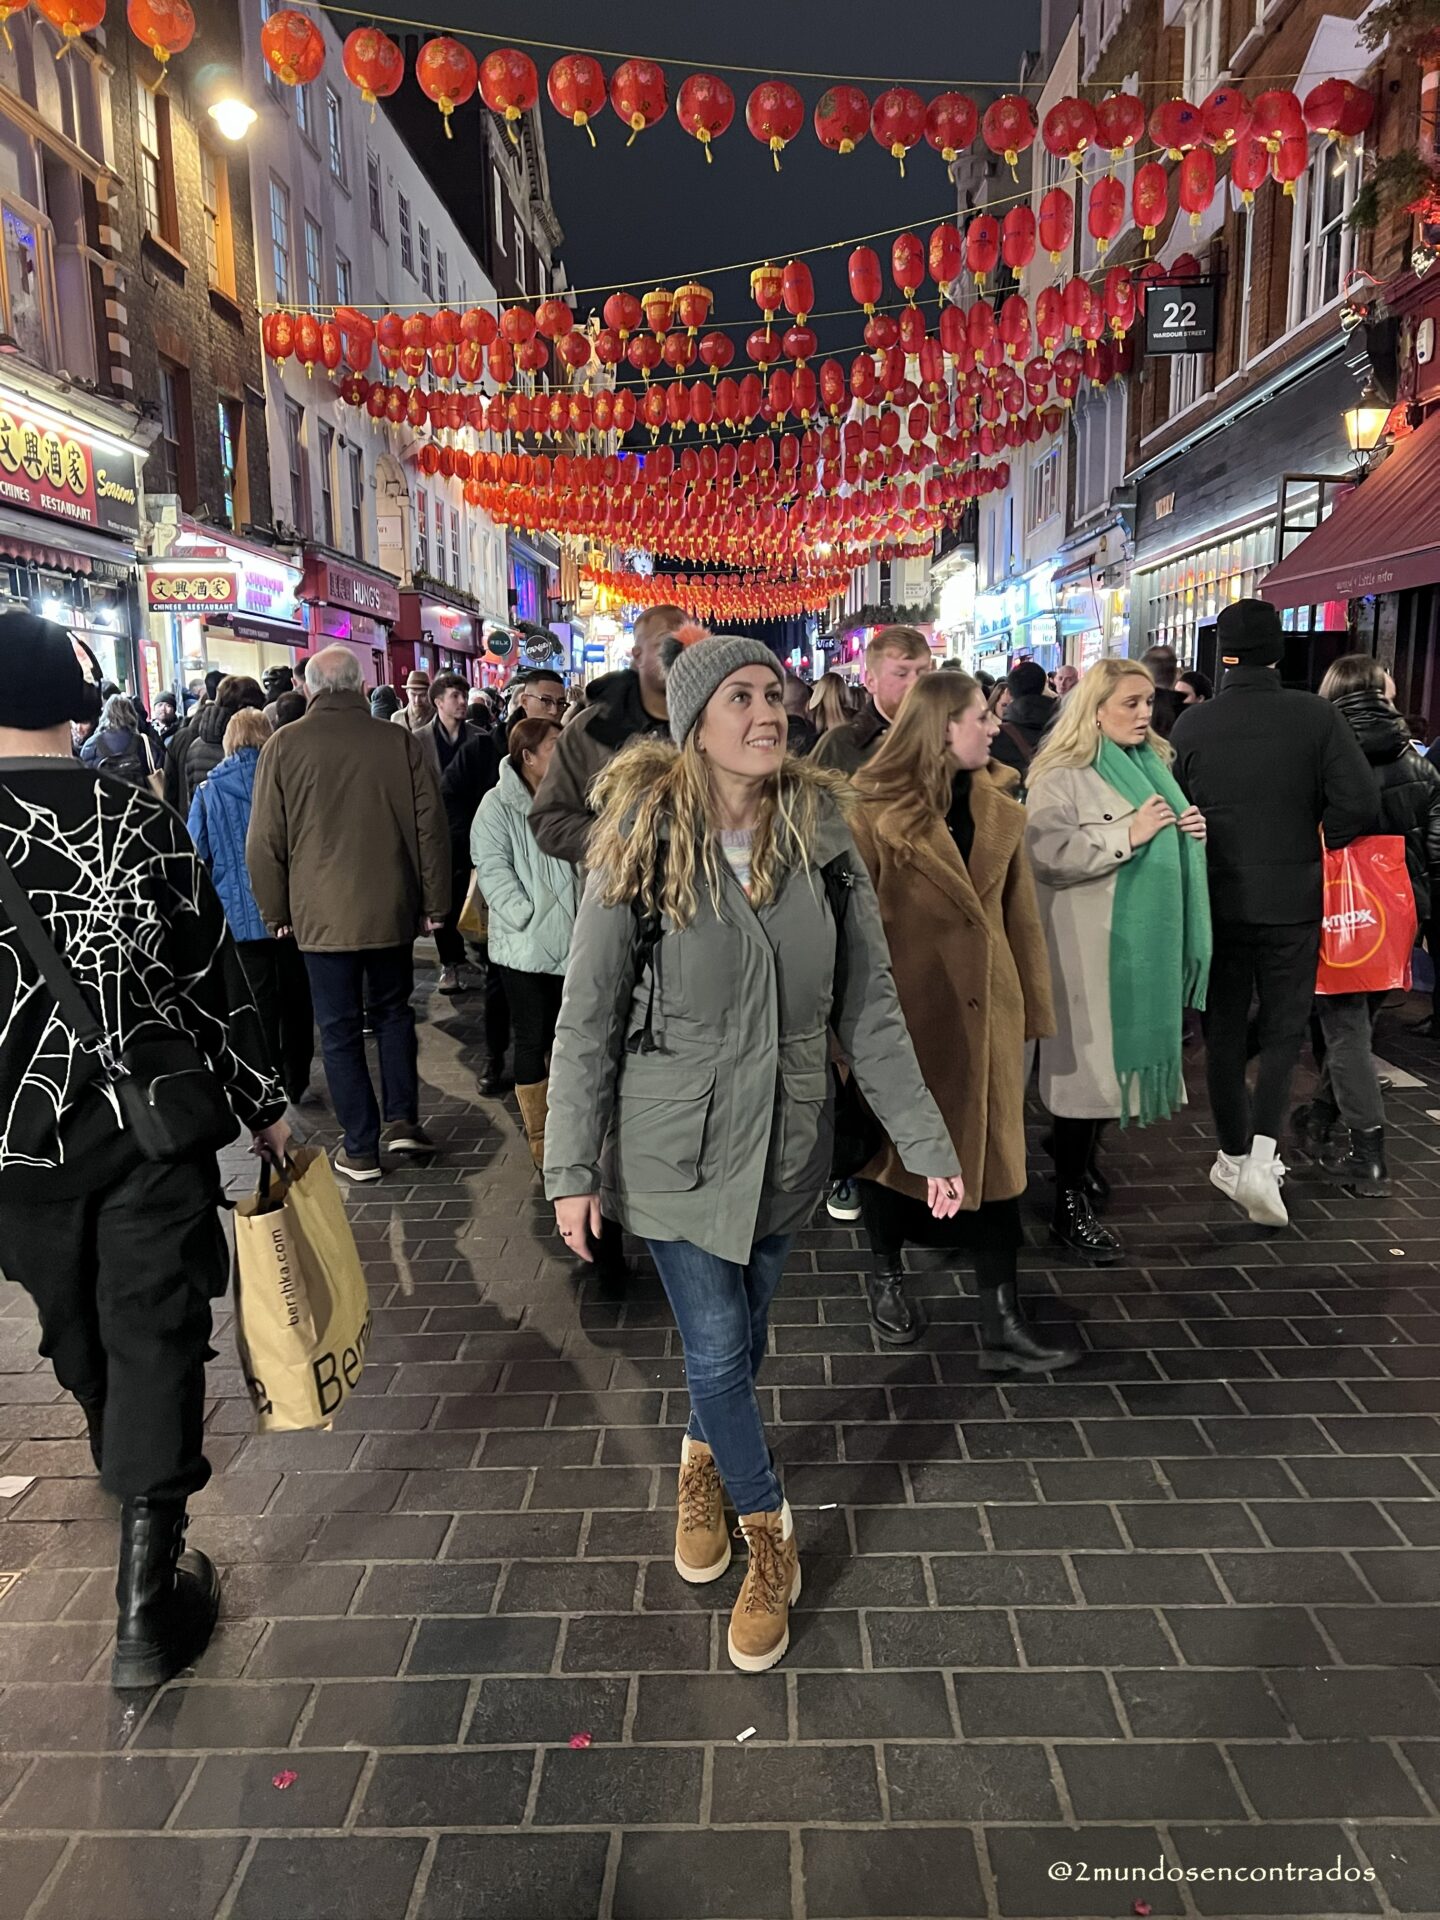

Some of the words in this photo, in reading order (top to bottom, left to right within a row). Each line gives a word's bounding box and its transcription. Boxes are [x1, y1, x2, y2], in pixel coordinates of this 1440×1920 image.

[1162, 301, 1196, 328] 22
[1152, 331, 1183, 339] WARDOUR
[1183, 329, 1206, 337] STREET
[40, 494, 91, 521] RESTAURANT
[154, 580, 228, 598] 文興酒家
[153, 603, 182, 611] CHINESE
[187, 603, 233, 611] RESTAURANT
[271, 1228, 300, 1326] bershka.com
